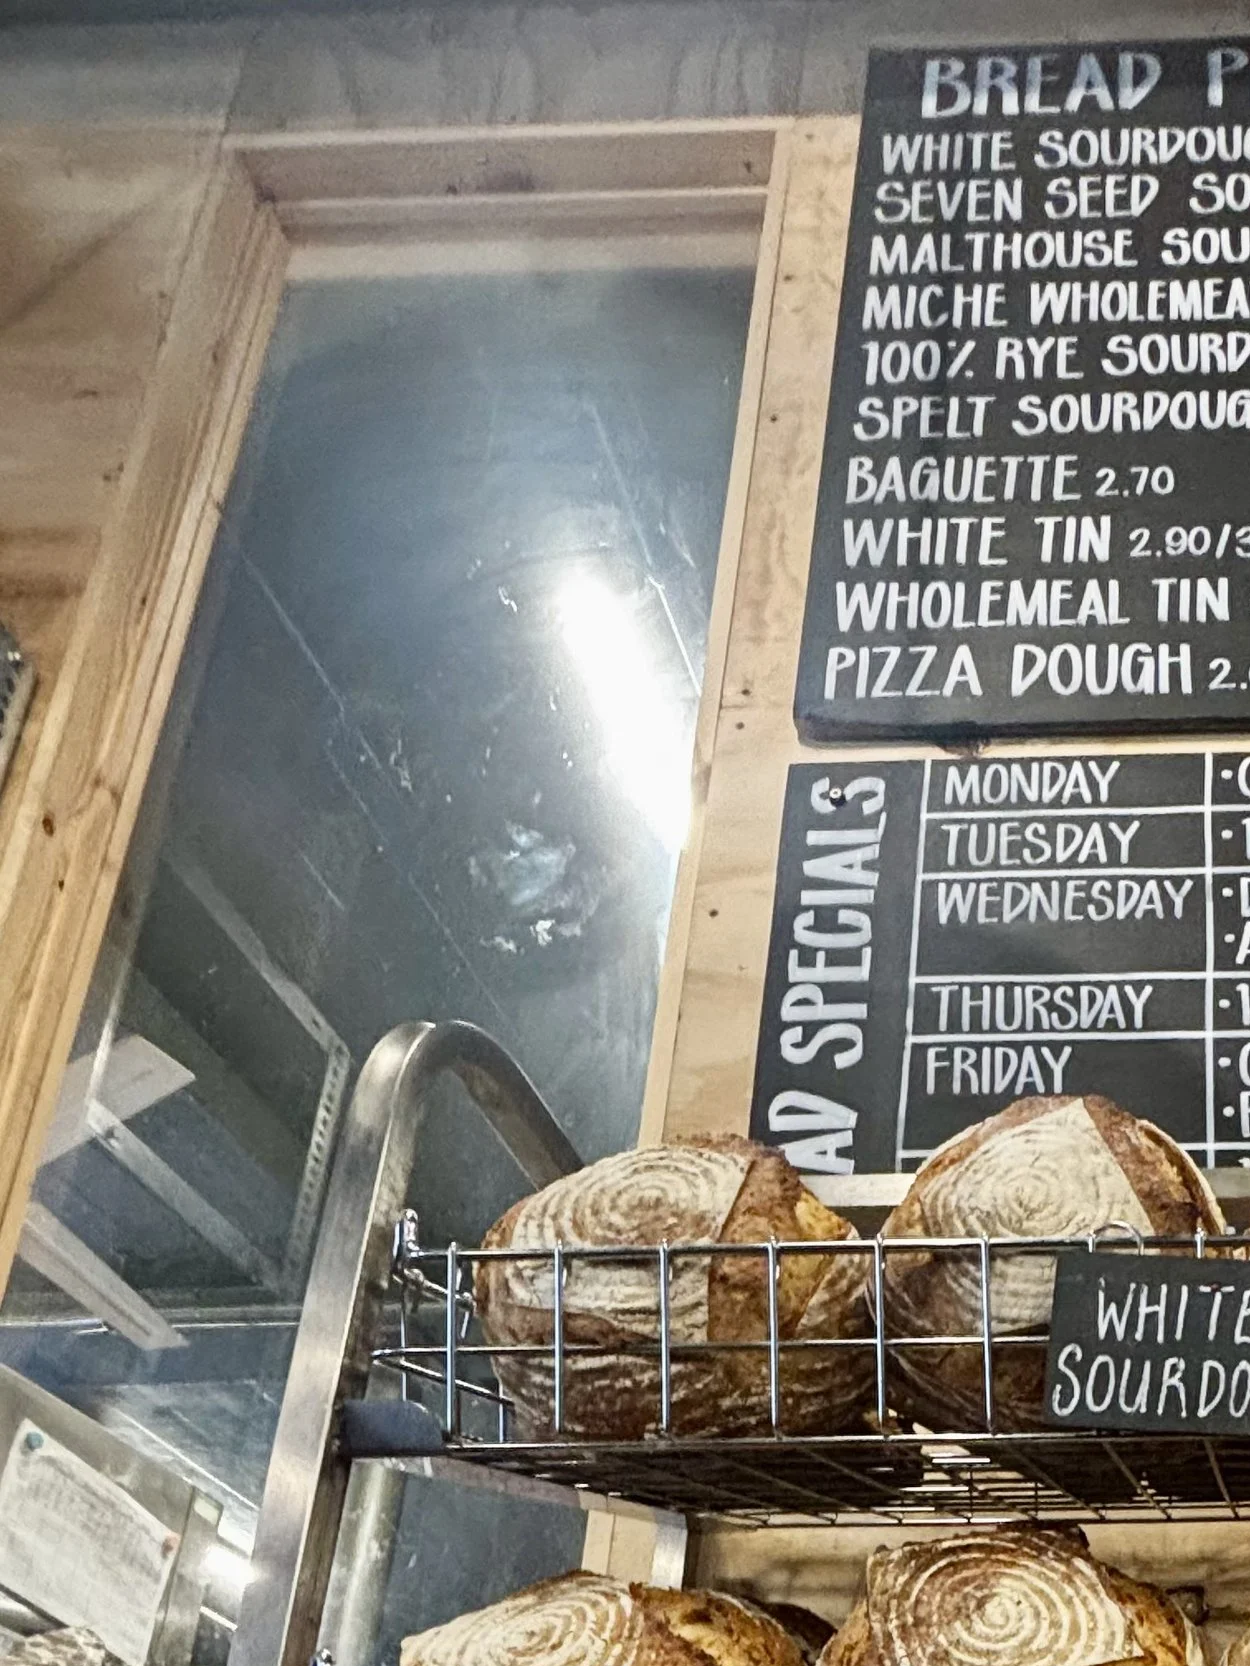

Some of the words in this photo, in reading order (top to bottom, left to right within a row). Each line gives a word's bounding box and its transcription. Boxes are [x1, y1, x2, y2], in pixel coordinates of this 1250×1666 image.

[922, 54, 1160, 118] BREAD
[883, 131, 1015, 174] WHITE
[874, 178, 1022, 223] SEVEN
[1044, 174, 1159, 219] SEED
[870, 230, 1138, 276] MALTHOUSE
[862, 284, 1007, 330] MICHE
[862, 340, 976, 386] 100%
[996, 336, 1083, 380] RYE
[853, 396, 996, 441] SPELT
[846, 455, 1081, 504] BAGUETTE
[1096, 466, 1174, 497] 2.70
[843, 517, 1008, 568] WHITE
[1034, 515, 1111, 563] TIN
[836, 579, 1130, 633] WHOLEMEAL
[1152, 577, 1229, 623] TIN
[824, 643, 983, 698] PIZZA
[1011, 643, 1192, 697] DOUGH
[945, 760, 1120, 806] MONDAY
[940, 820, 1140, 867] TUESDAY
[779, 775, 887, 1070] SPECIALS
[938, 879, 1193, 925] WEDNESDAY
[930, 985, 1153, 1031] THURSDAY
[927, 1046, 1072, 1094] FRIDAY
